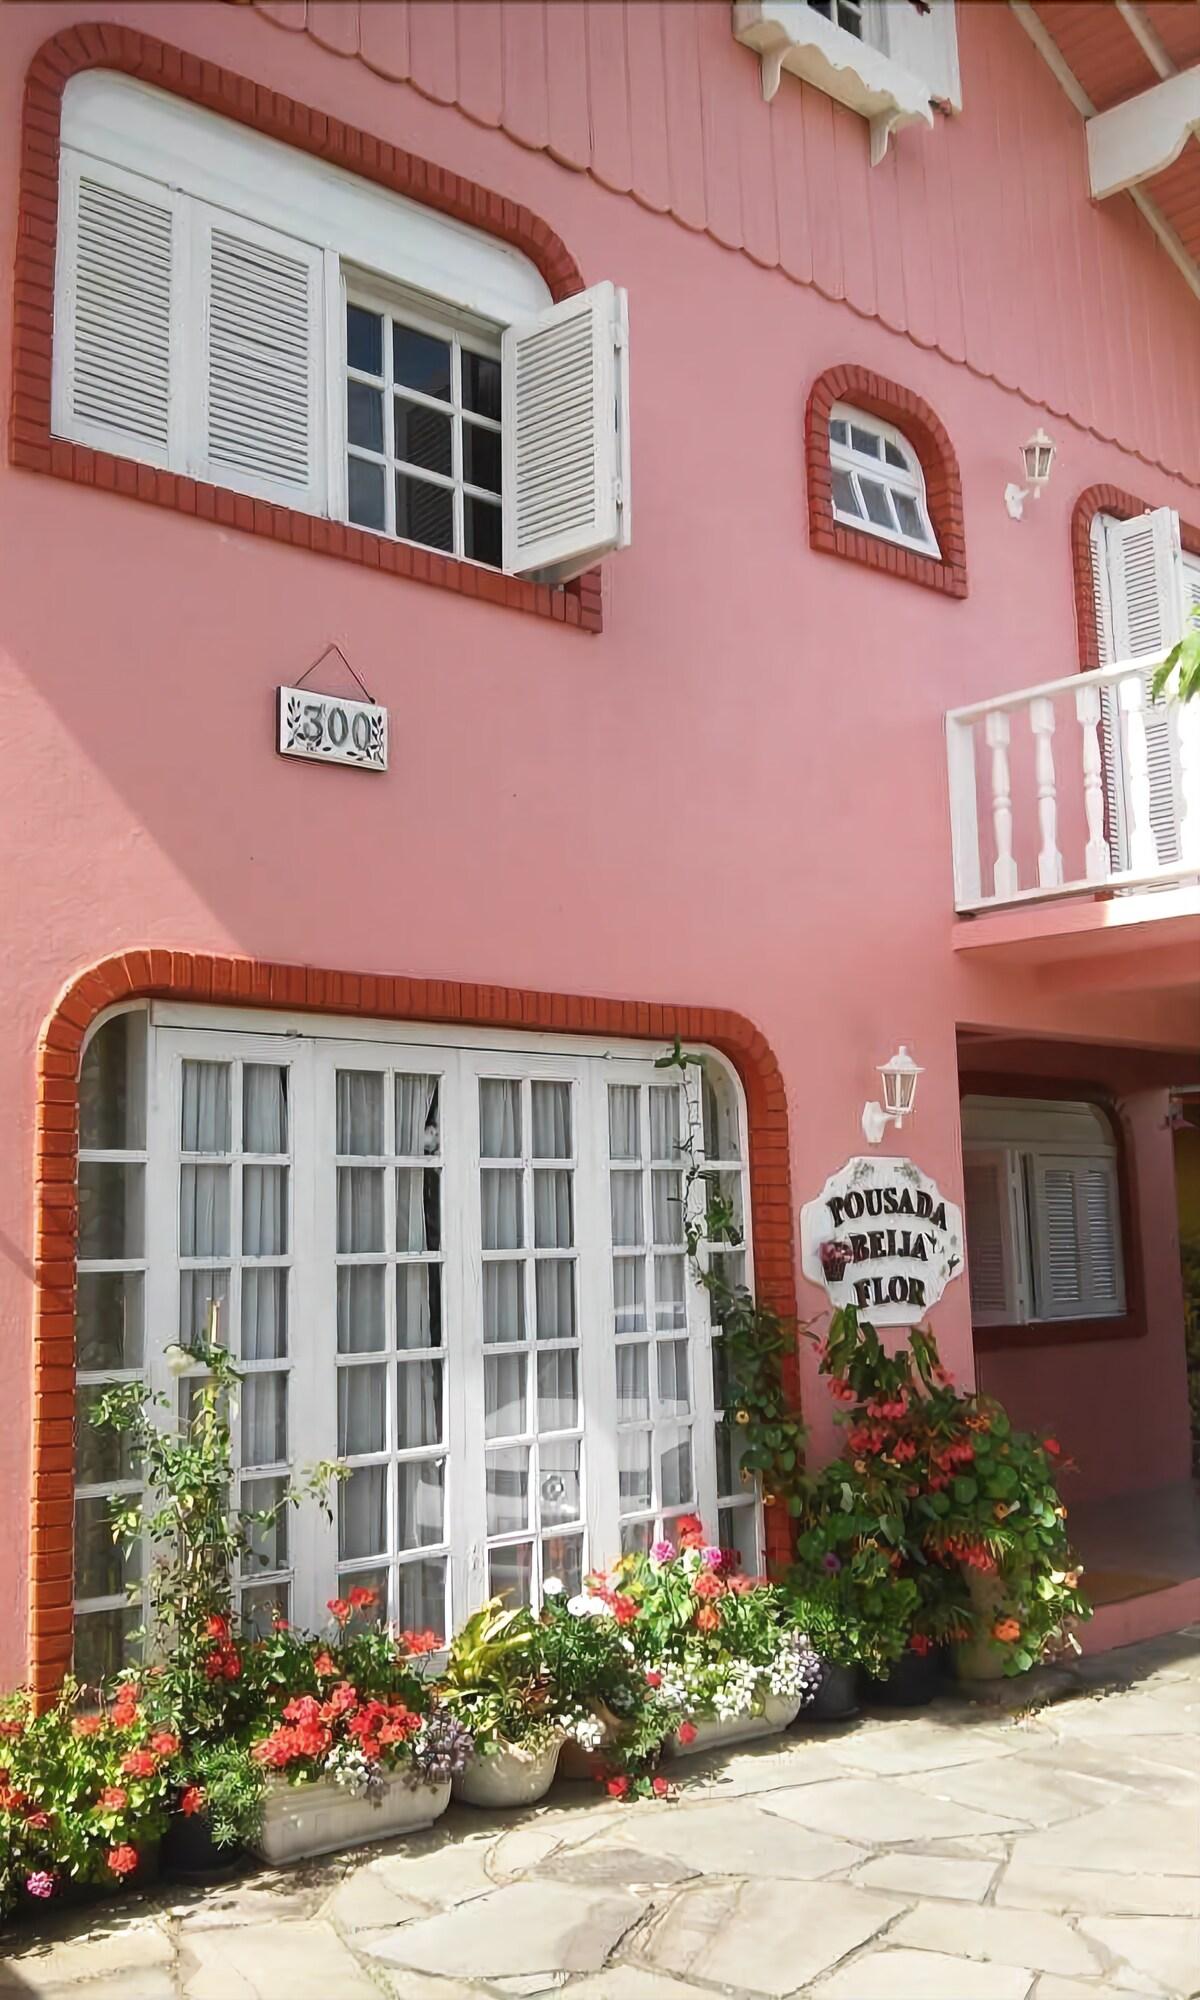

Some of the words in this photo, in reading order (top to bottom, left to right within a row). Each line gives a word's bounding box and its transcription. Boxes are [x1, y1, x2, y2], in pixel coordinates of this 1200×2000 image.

[303, 704, 371, 751] 300
[826, 1187, 947, 1231] POUSADA
[849, 1229, 928, 1264] BEIJA
[853, 1276, 926, 1309] FLOR
